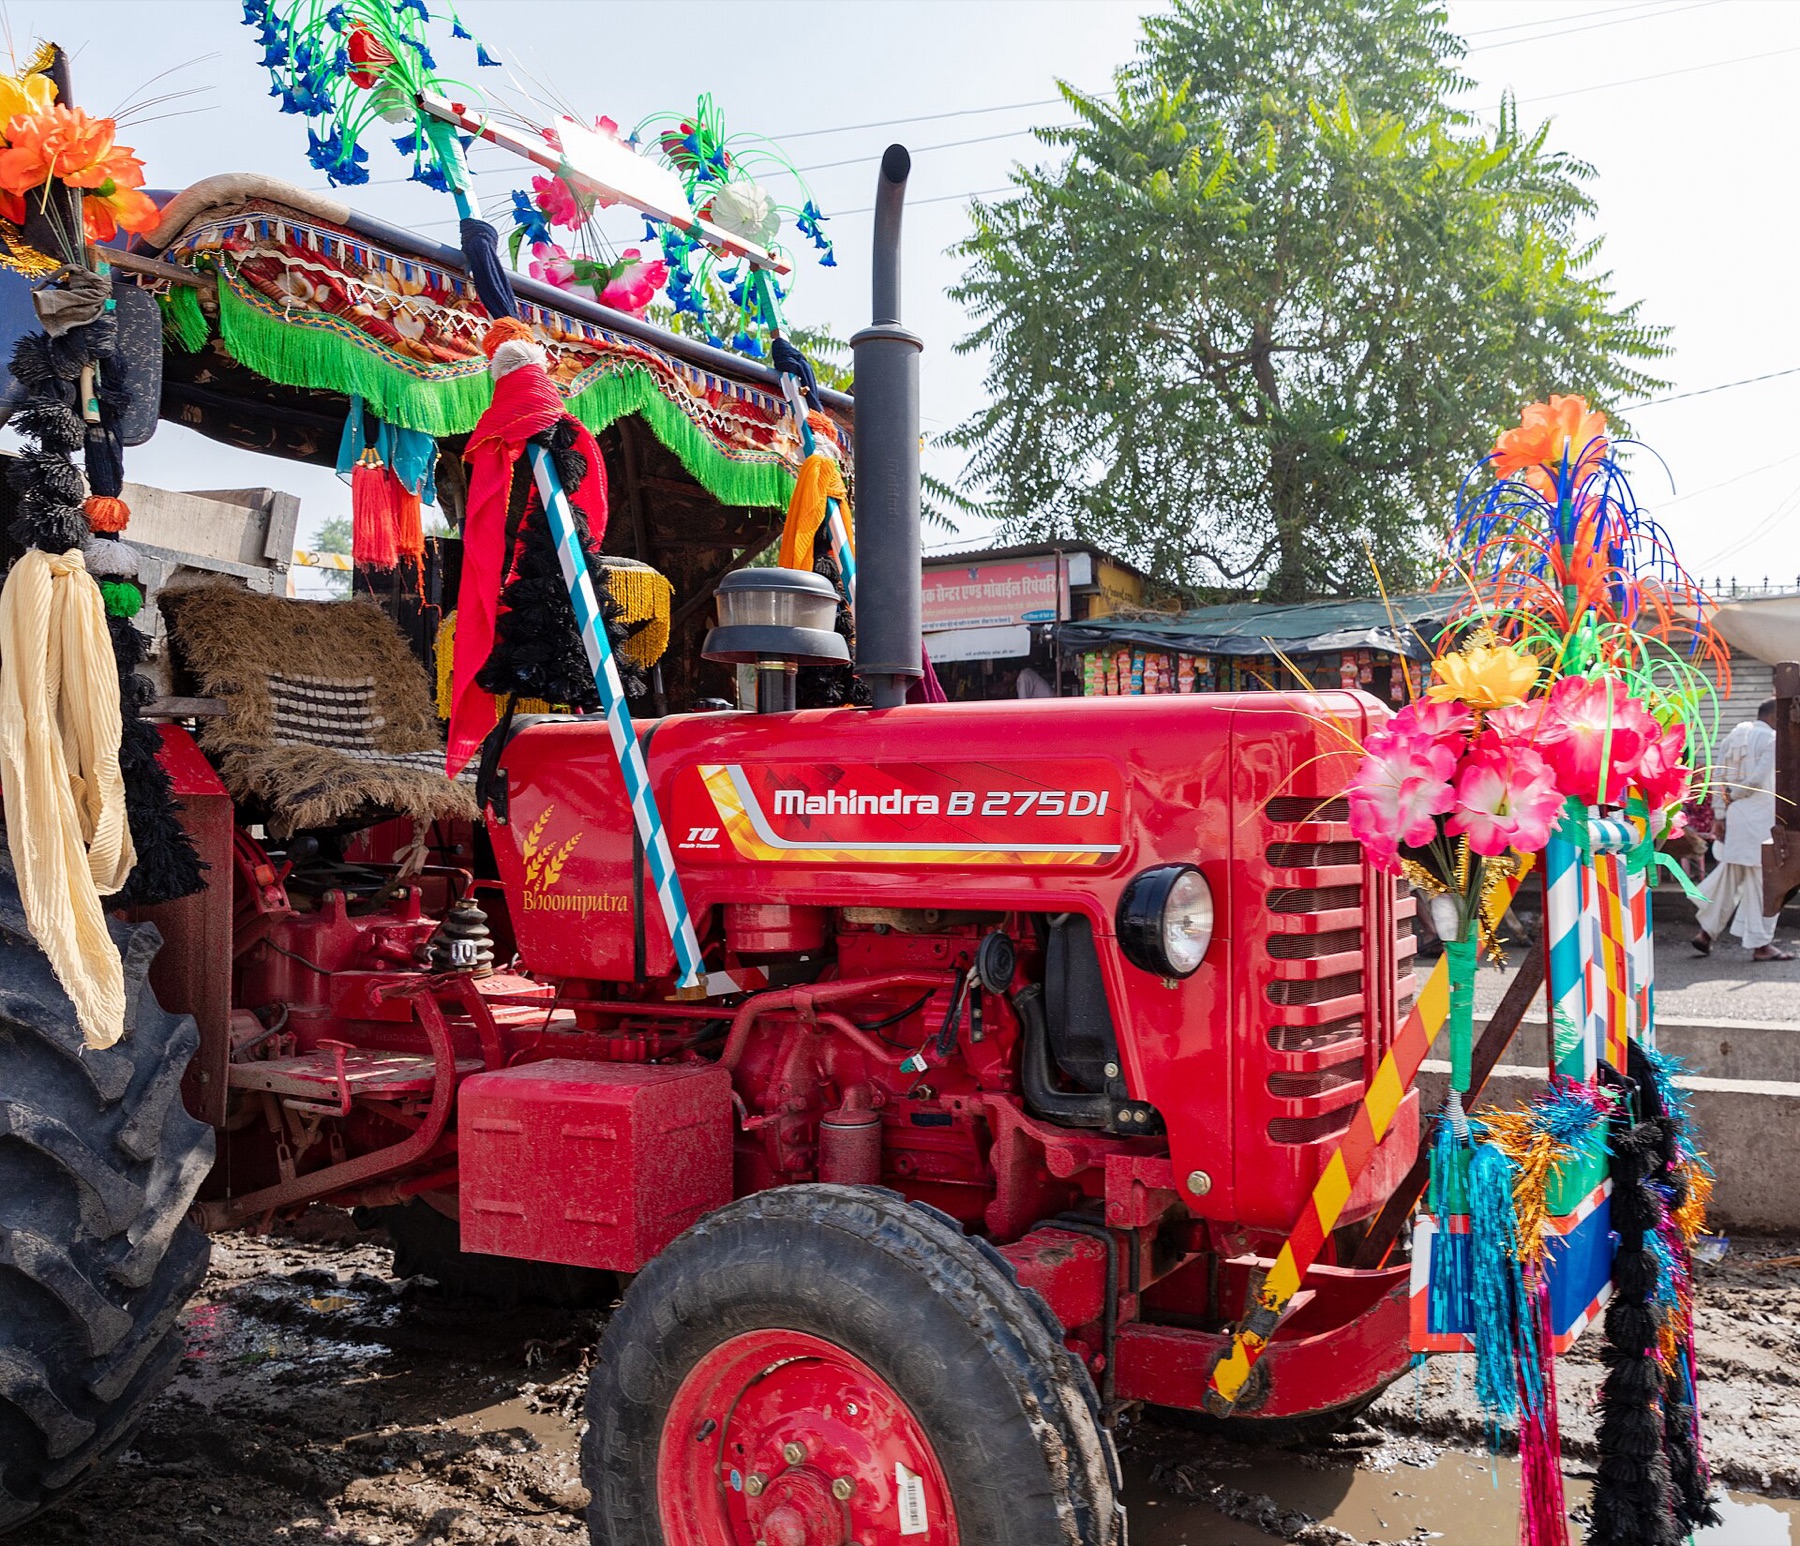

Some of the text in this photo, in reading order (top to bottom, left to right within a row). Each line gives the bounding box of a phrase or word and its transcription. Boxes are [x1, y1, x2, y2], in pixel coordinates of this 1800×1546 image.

[774, 789, 939, 814] Mahindra
[946, 791, 976, 816] B
[686, 827, 719, 841] TU
[522, 890, 628, 919] Bhoomiputra
